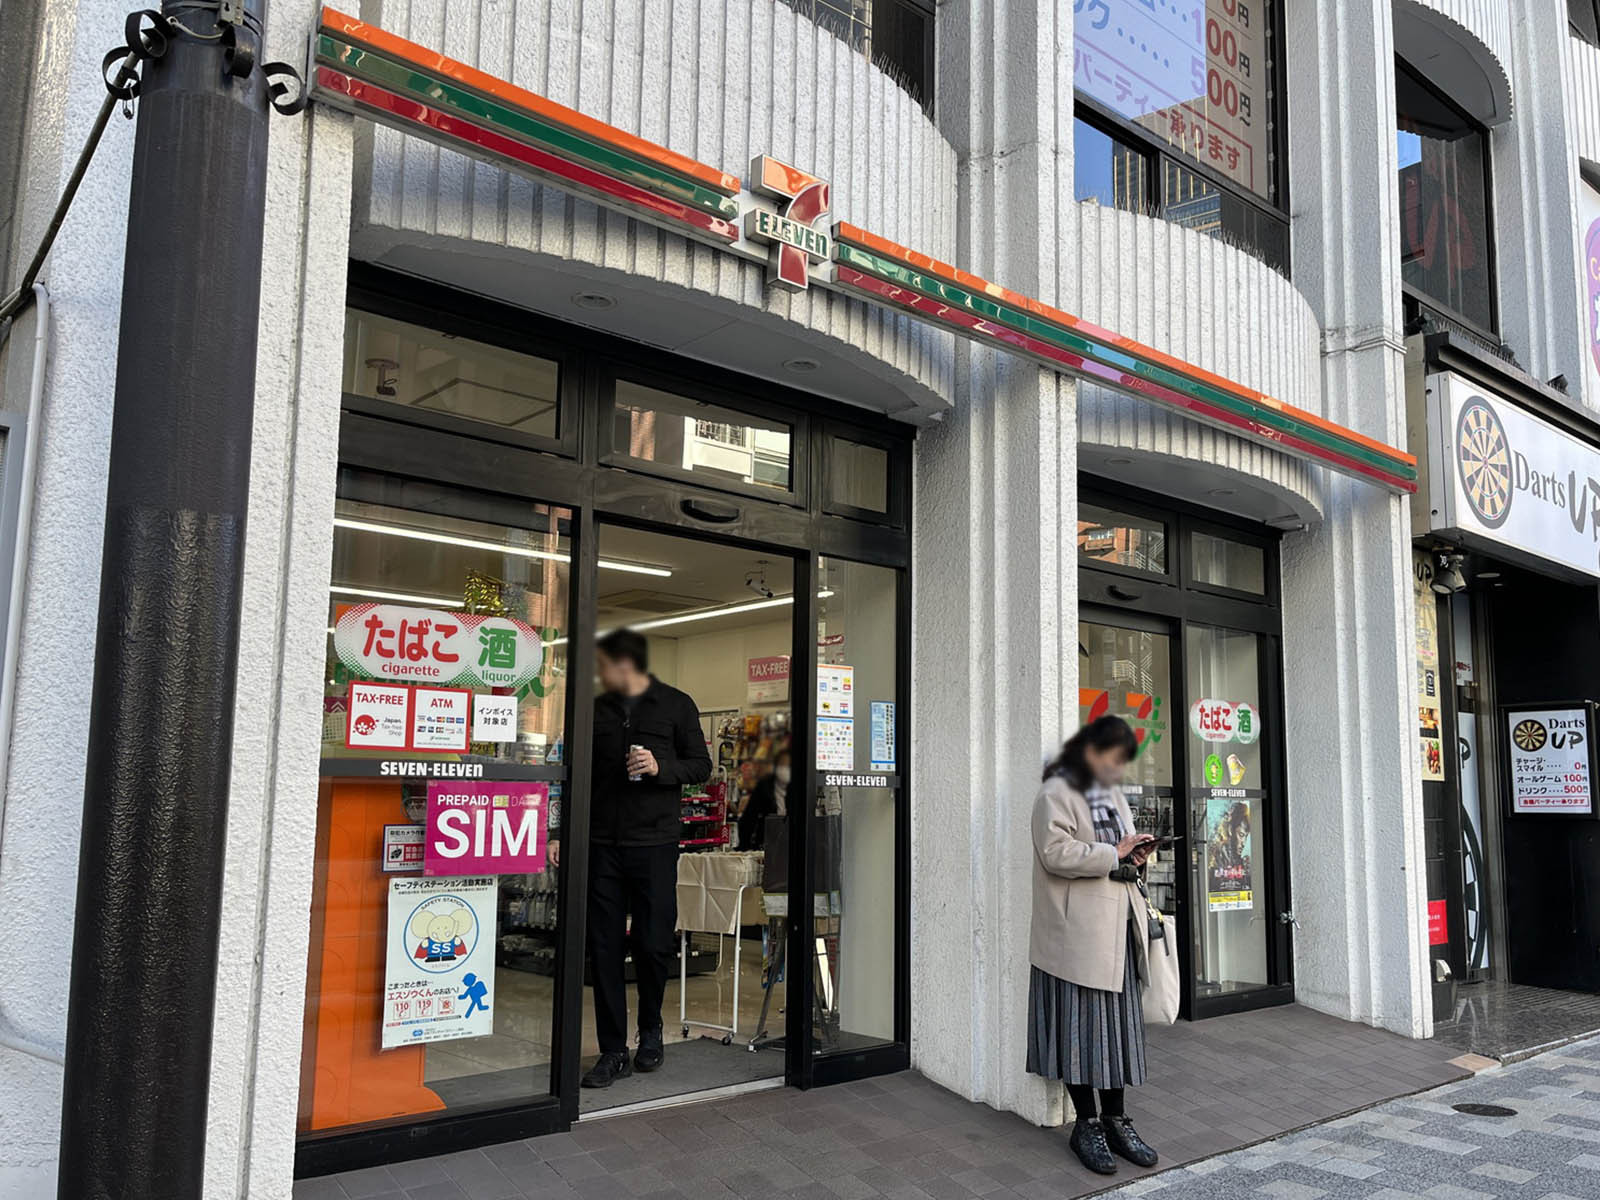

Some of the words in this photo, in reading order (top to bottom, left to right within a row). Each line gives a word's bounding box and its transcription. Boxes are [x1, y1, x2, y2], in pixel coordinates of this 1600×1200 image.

[1191, 8, 1250, 78] 100円
[1512, 449, 1566, 509] Darts
[363, 614, 460, 663] たばこ
[477, 625, 518, 670] 酒
[381, 662, 441, 677] cigarette
[481, 669, 517, 683] liquor
[355, 692, 404, 706] TAX-FREE
[430, 698, 454, 709] ATM
[478, 707, 514, 717] インボイス
[1199, 705, 1232, 731] たばこ
[1237, 708, 1252, 733] 酒
[483, 716, 509, 727] 対象店
[1548, 718, 1585, 730] Darts
[1551, 730, 1585, 750] UP
[1517, 775, 1562, 784] オールゲーム
[1518, 786, 1548, 795] ドリンク
[437, 794, 490, 807] PREPAID
[434, 808, 539, 859] SIM
[431, 941, 452, 955] SS
[395, 1002, 409, 1012] 110
[418, 999, 432, 1009] 119
